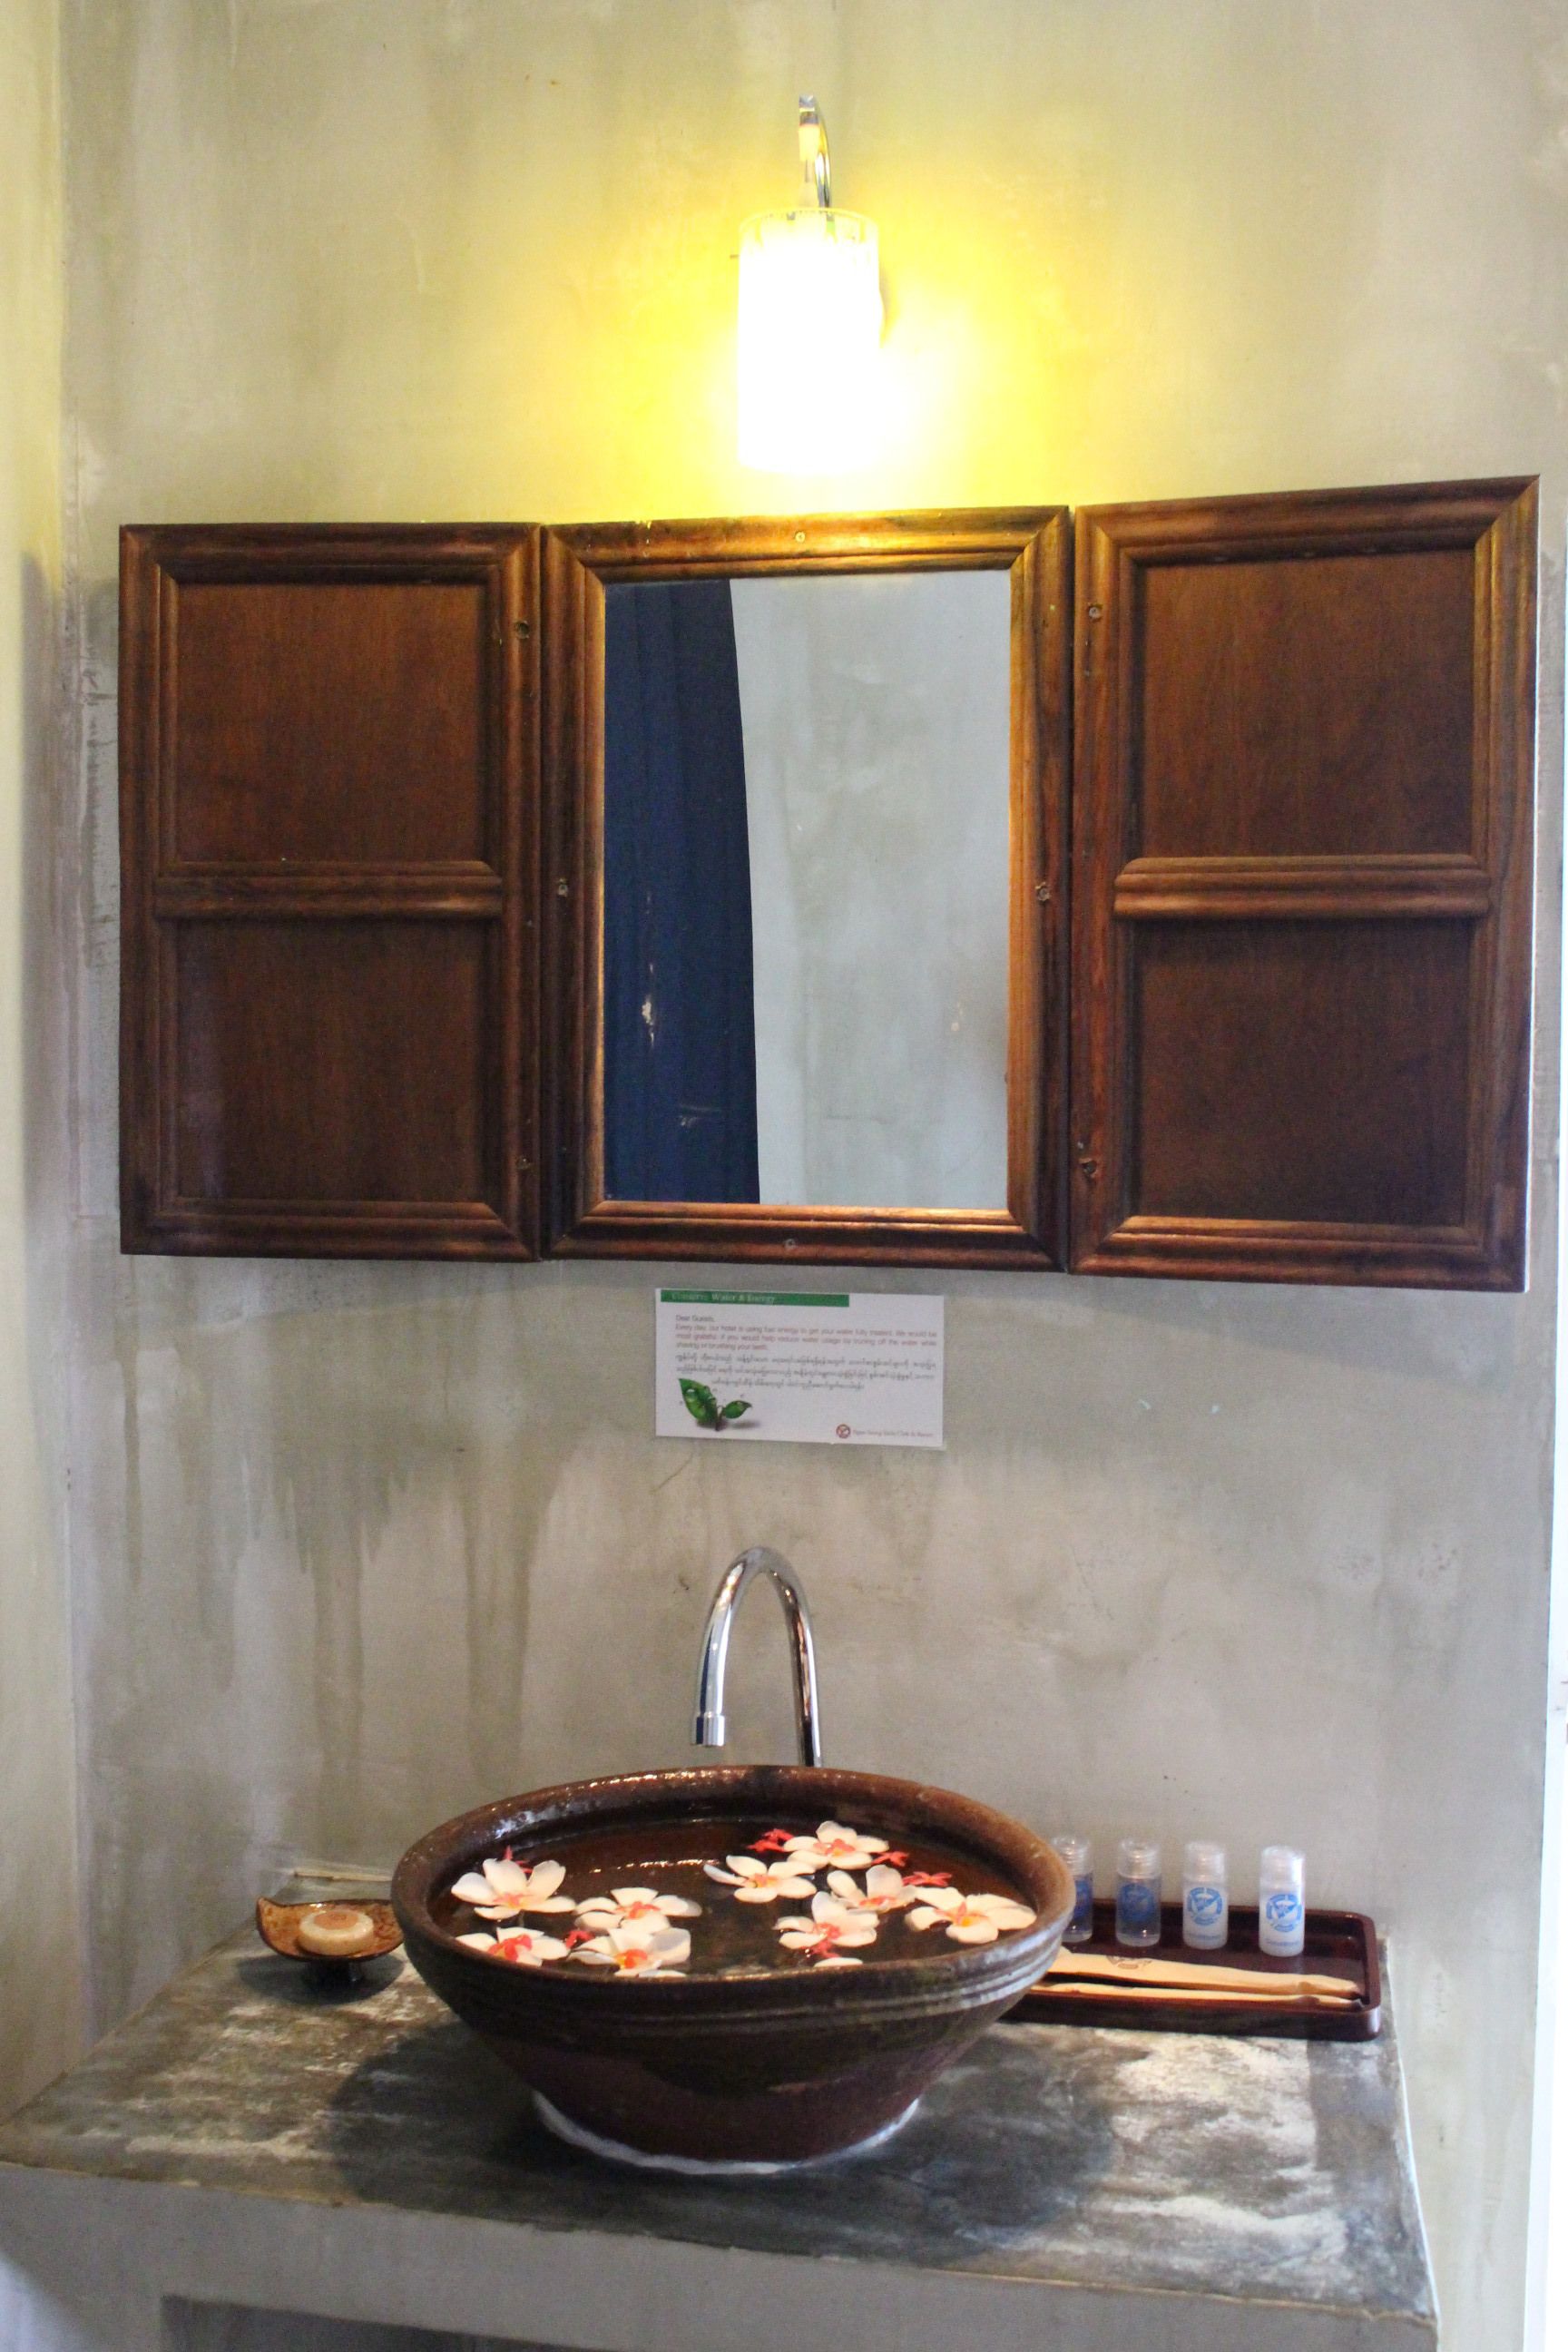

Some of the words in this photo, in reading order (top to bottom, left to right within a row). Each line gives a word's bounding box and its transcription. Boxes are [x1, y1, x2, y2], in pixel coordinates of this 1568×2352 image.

[711, 1293, 736, 1301] Water
[675, 1324, 691, 1332] Every
[745, 1326, 763, 1334] using
